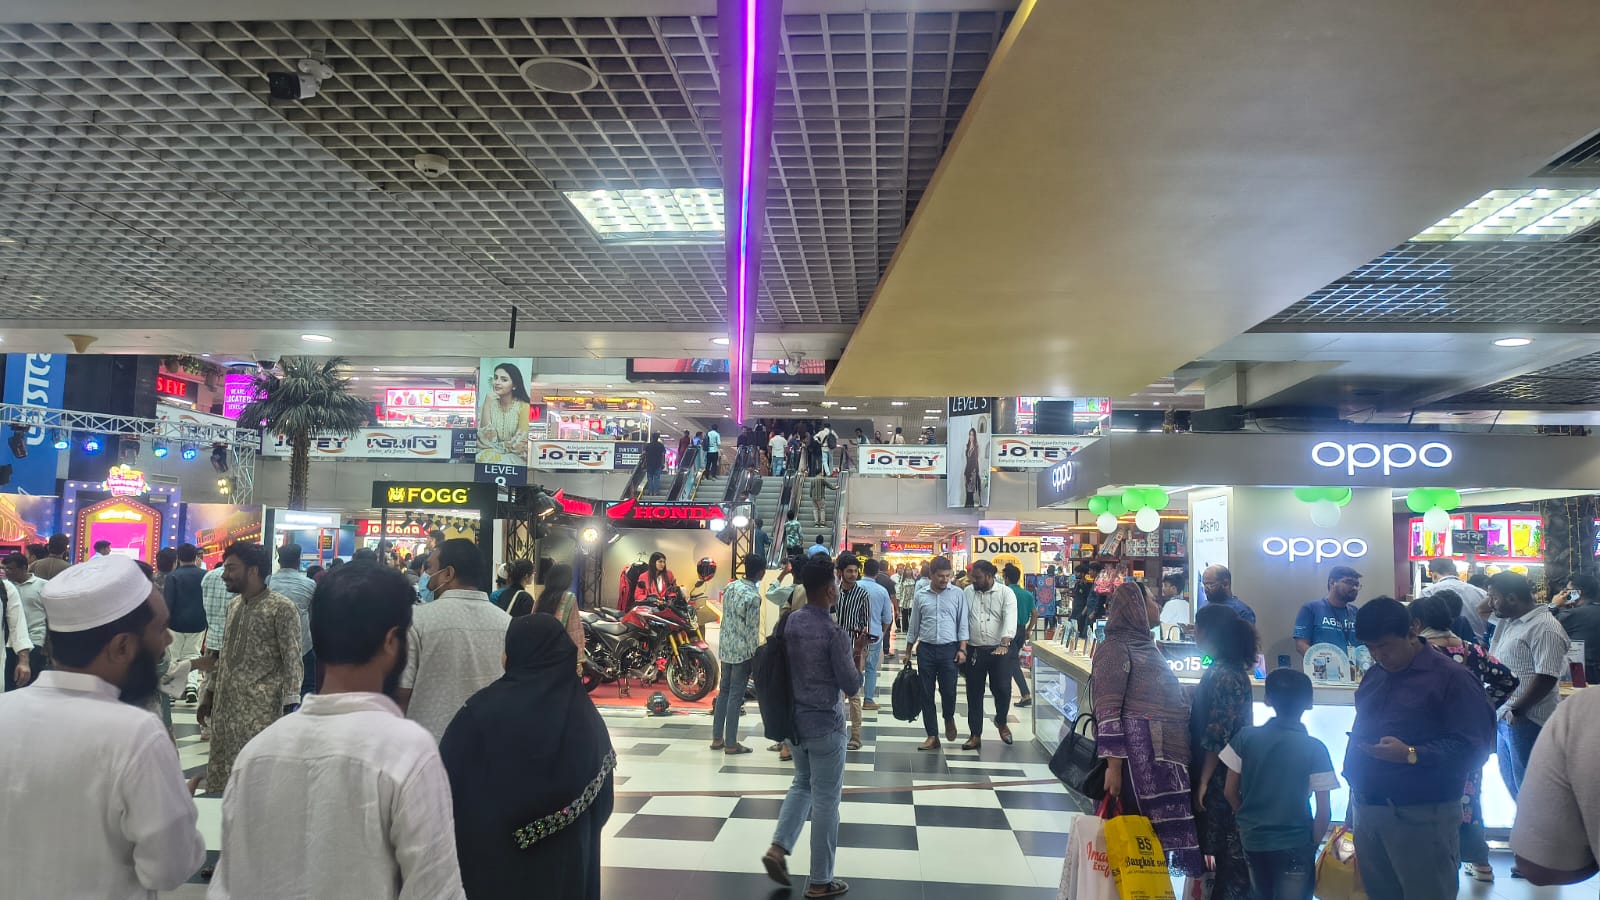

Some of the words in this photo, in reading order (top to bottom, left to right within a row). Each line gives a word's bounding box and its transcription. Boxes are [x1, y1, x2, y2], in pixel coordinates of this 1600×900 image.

[166, 378, 187, 397] EYE
[952, 397, 979, 412] LEVEL
[538, 449, 608, 461] JOTEY
[867, 453, 940, 466] JOTEY
[997, 444, 1079, 459] JOTEY
[1311, 441, 1453, 476] oppo
[484, 465, 518, 475] LEVEL
[1052, 460, 1073, 493] oppo
[407, 487, 468, 504] FOGG
[633, 505, 727, 520] HONDA
[365, 519, 420, 536] jodana
[973, 537, 1039, 554] Dohora
[1263, 537, 1368, 563] oppo
[1135, 837, 1152, 851] BS
